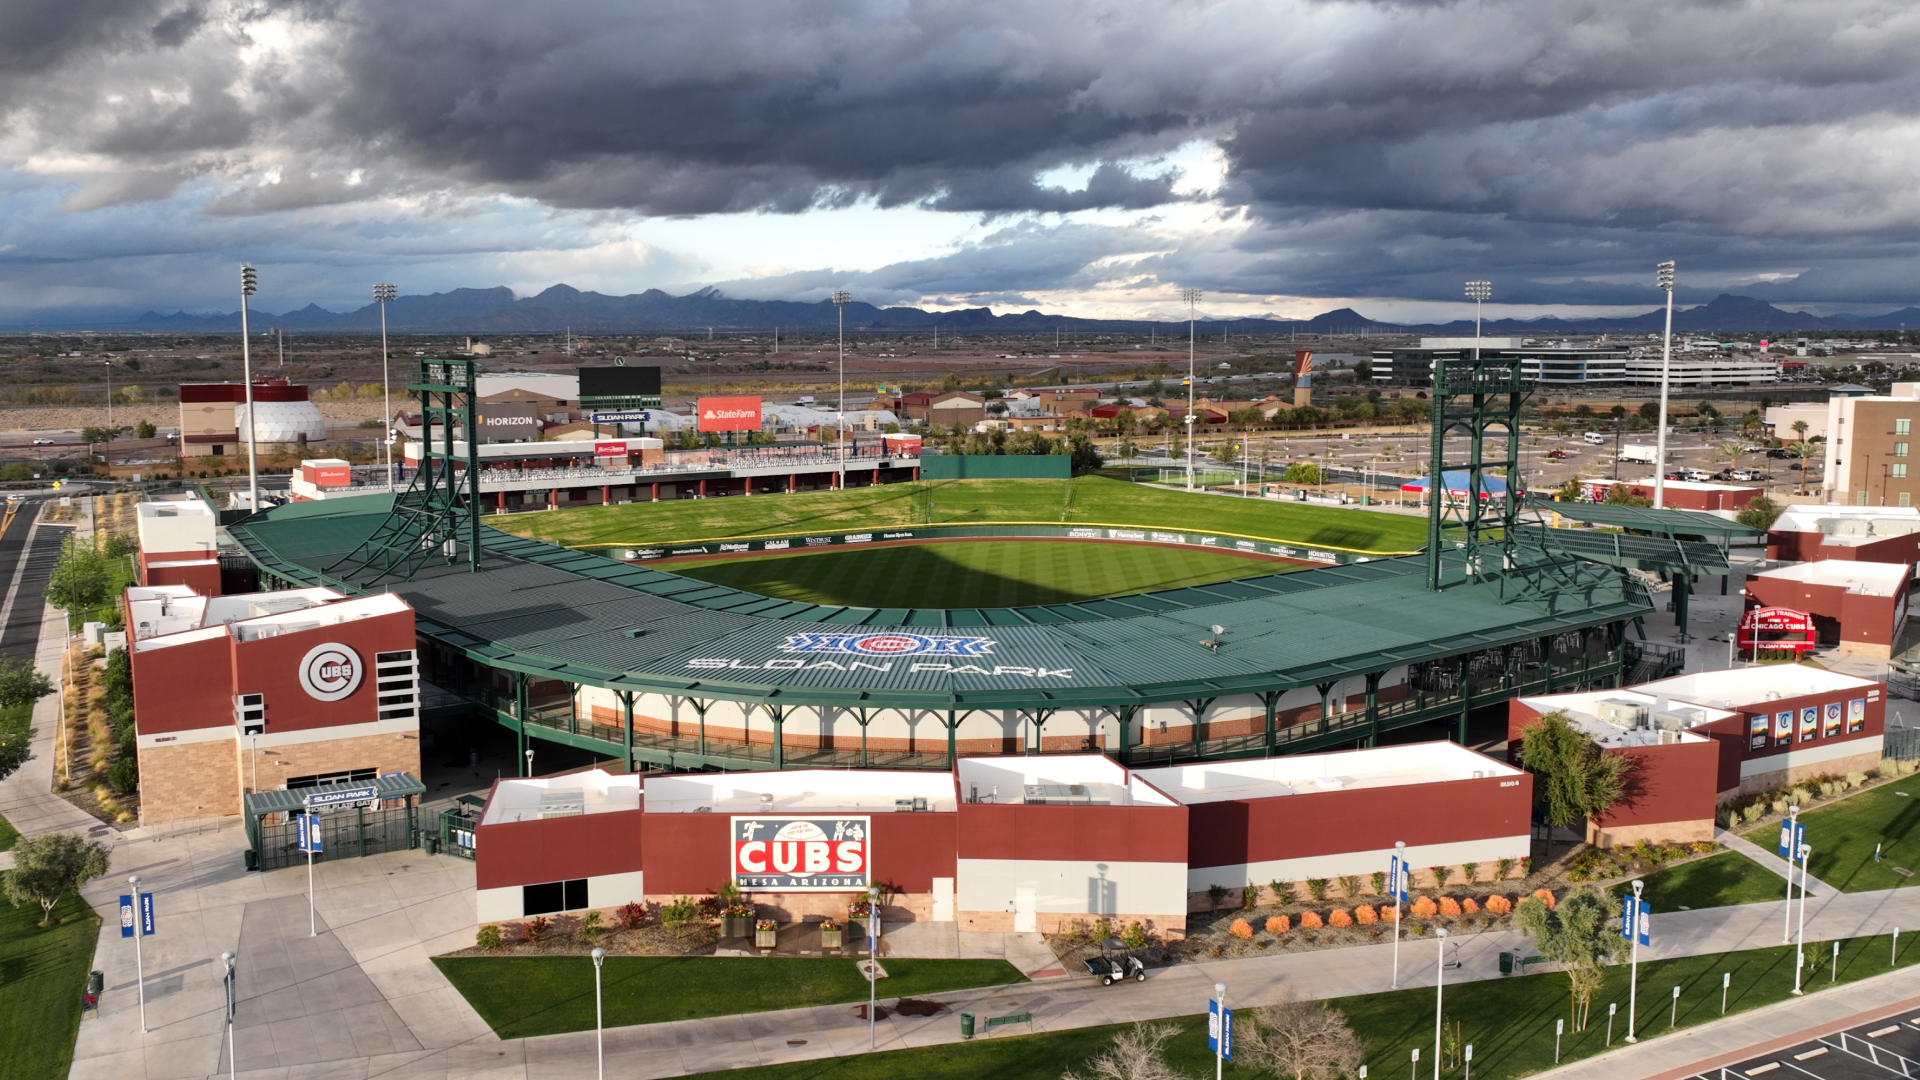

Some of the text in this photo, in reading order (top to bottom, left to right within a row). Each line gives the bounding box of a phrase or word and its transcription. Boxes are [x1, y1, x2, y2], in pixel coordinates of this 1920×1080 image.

[486, 416, 533, 427] HORIZON
[1580, 488, 1609, 501] DECK
[1308, 549, 1336, 560] HORNITOS
[1776, 610, 1805, 620] TRAINING
[684, 657, 1074, 679] SLOAN PARK
[313, 790, 371, 803] SLOAN PARK
[332, 801, 355, 810] PLATE
[739, 841, 863, 873] CUBS
[740, 878, 863, 886] MESA ARIZONA
